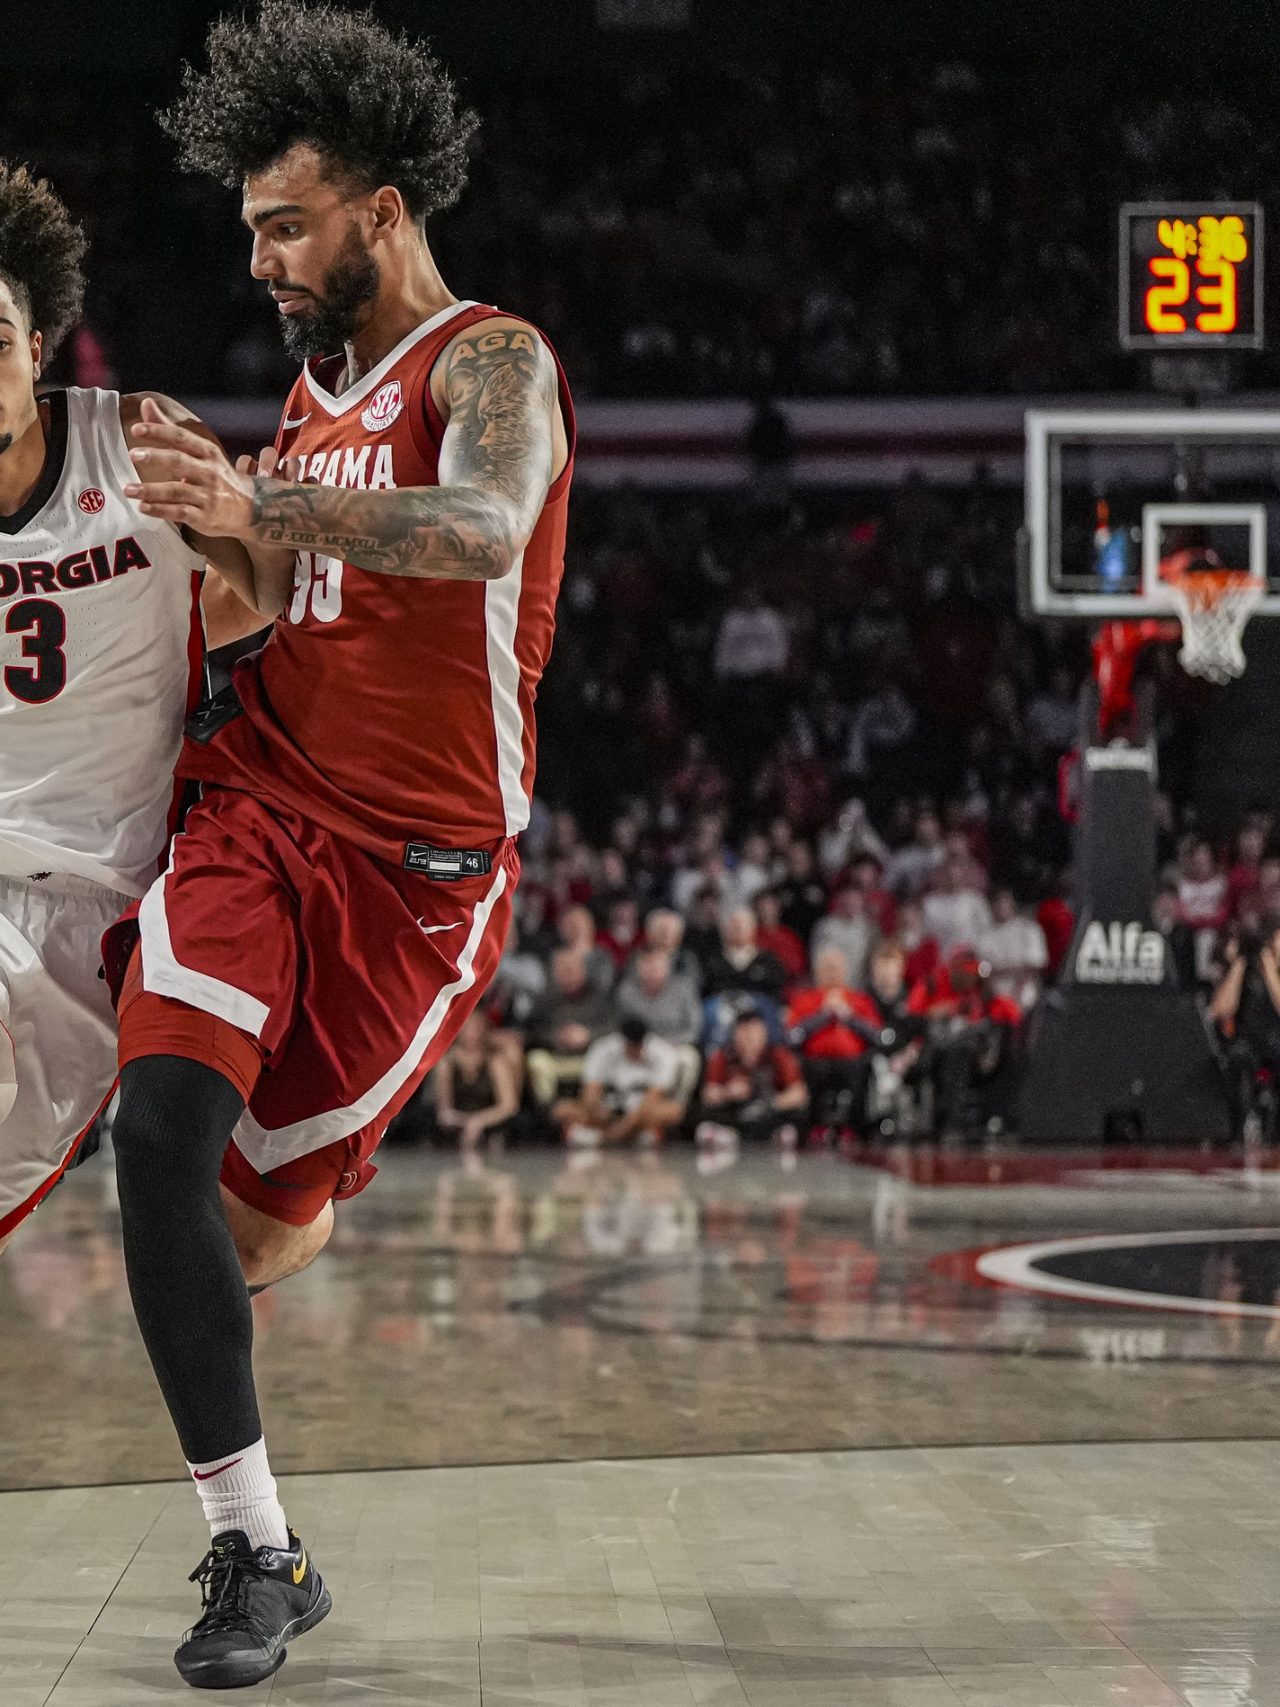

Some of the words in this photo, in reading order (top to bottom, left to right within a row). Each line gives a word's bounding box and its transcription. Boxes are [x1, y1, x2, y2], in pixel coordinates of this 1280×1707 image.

[1146, 257, 1236, 333] 23
[371, 383, 400, 418] SEC
[80, 490, 103, 512] SEC
[4, 597, 67, 705] 3
[466, 857, 479, 869] 46
[1076, 920, 1164, 969] Alfa
